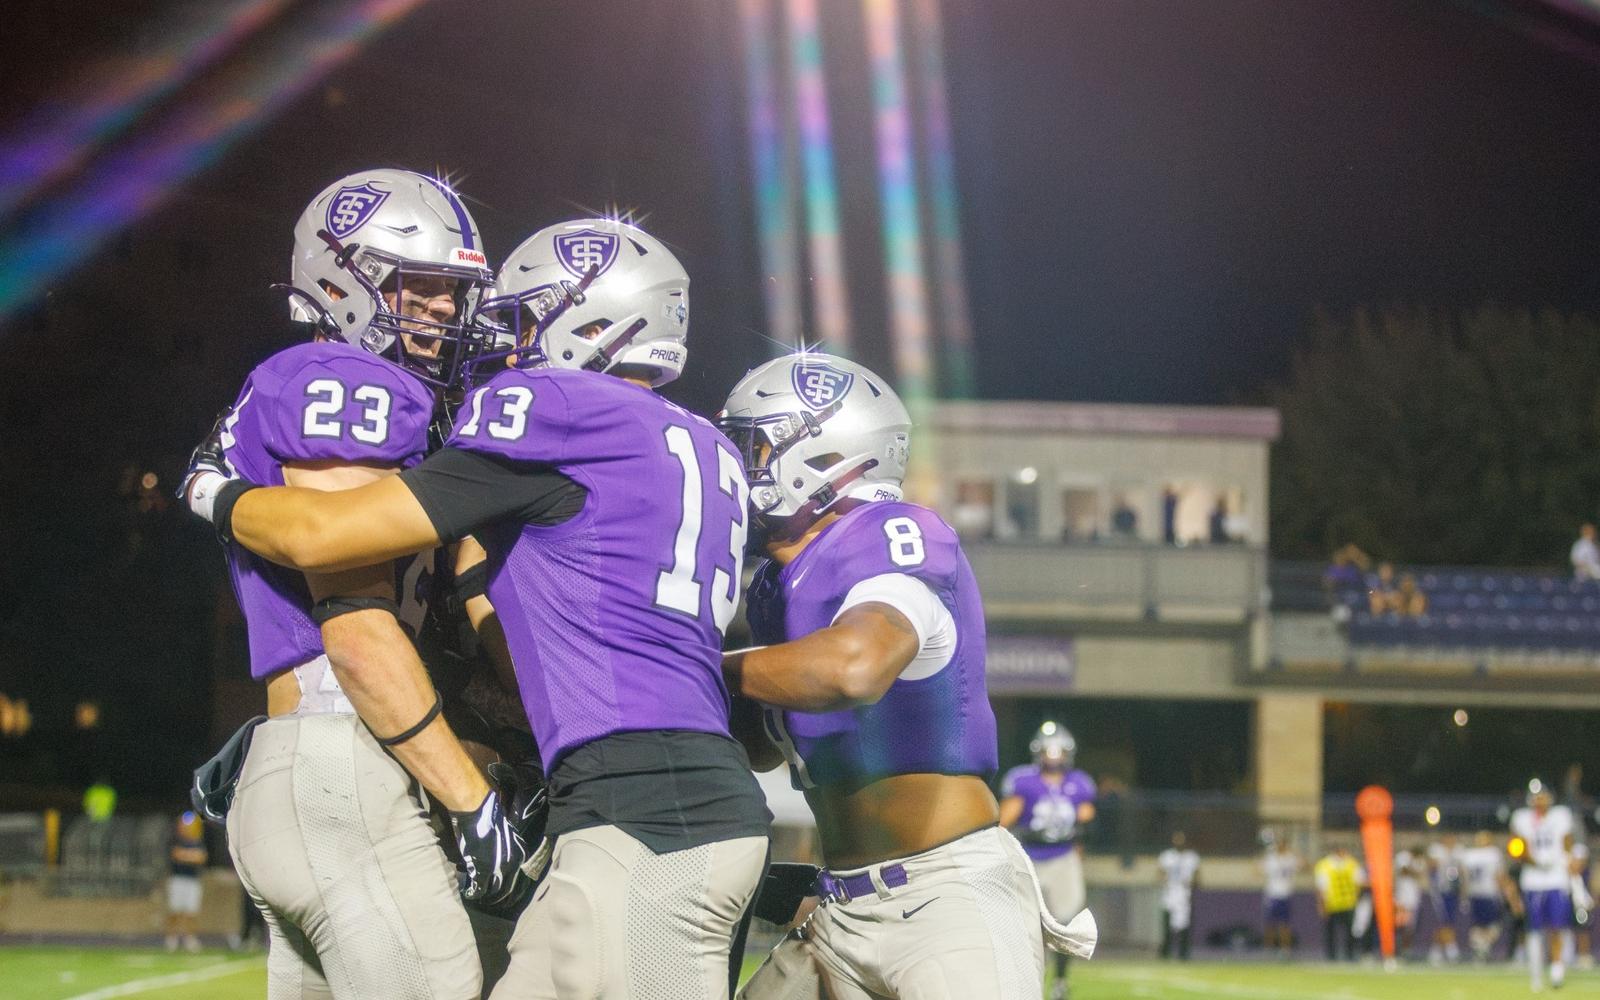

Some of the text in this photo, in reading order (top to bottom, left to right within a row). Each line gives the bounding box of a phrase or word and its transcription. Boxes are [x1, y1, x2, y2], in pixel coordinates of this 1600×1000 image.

[649, 348, 681, 363] PRIDE
[302, 378, 391, 447] 23
[457, 384, 534, 443] 13
[654, 422, 750, 638] 13
[882, 515, 926, 567] 8
